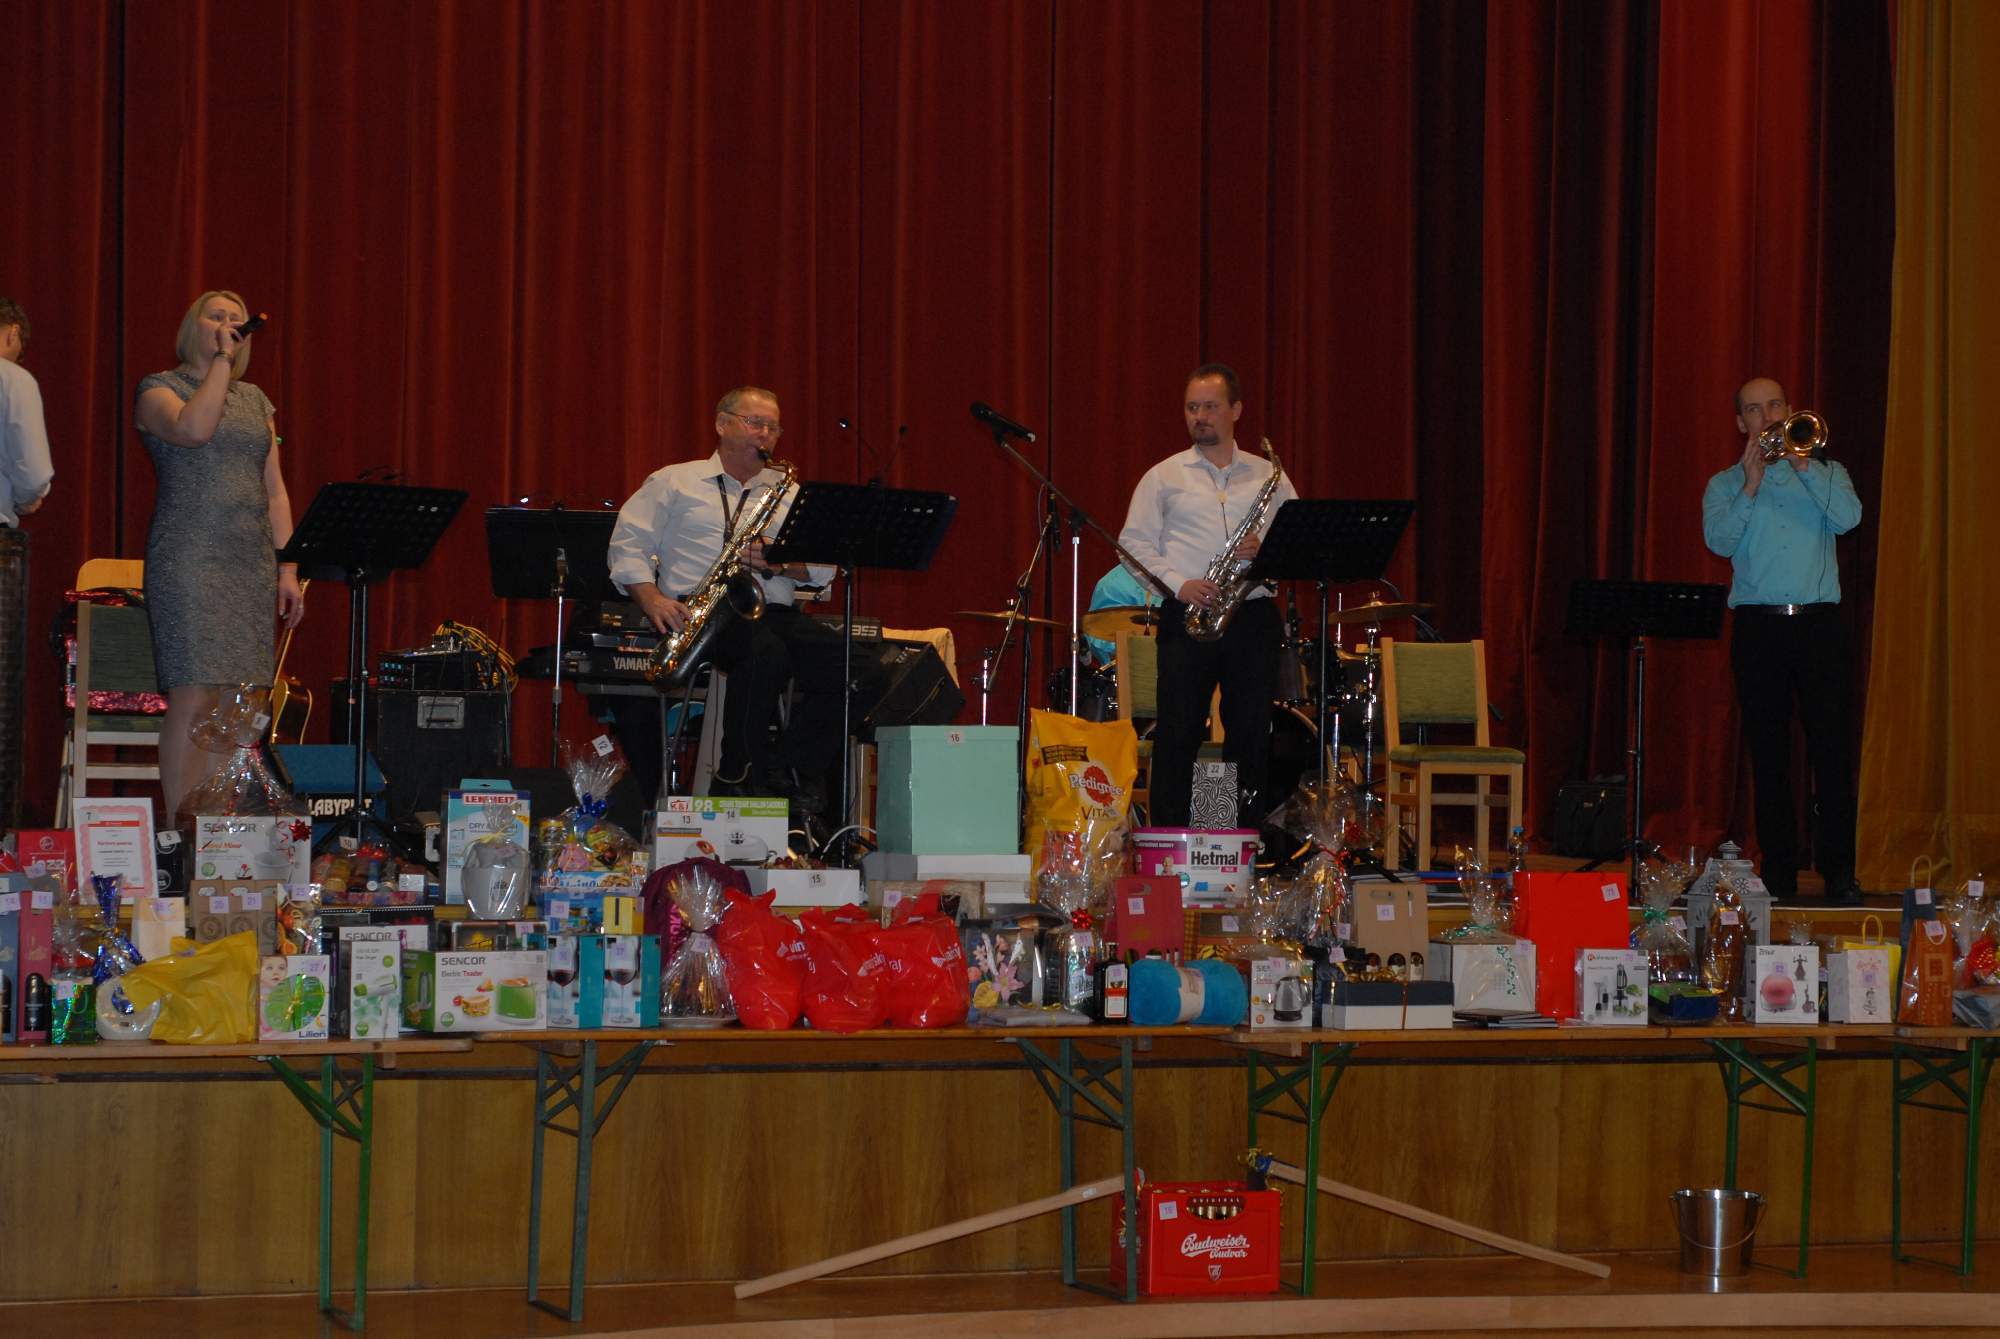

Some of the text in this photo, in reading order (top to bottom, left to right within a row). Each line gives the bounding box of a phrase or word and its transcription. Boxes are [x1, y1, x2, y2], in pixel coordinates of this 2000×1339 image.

[613, 656, 652, 670] YAMAH
[1069, 773, 1123, 797] Pedigree
[1191, 851, 1239, 865] Hetmal
[345, 931, 392, 941] SENCOR
[441, 956, 486, 966] SENCOR
[1181, 1233, 1251, 1258] Budweiser
[1209, 1246, 1248, 1260] Budvar
